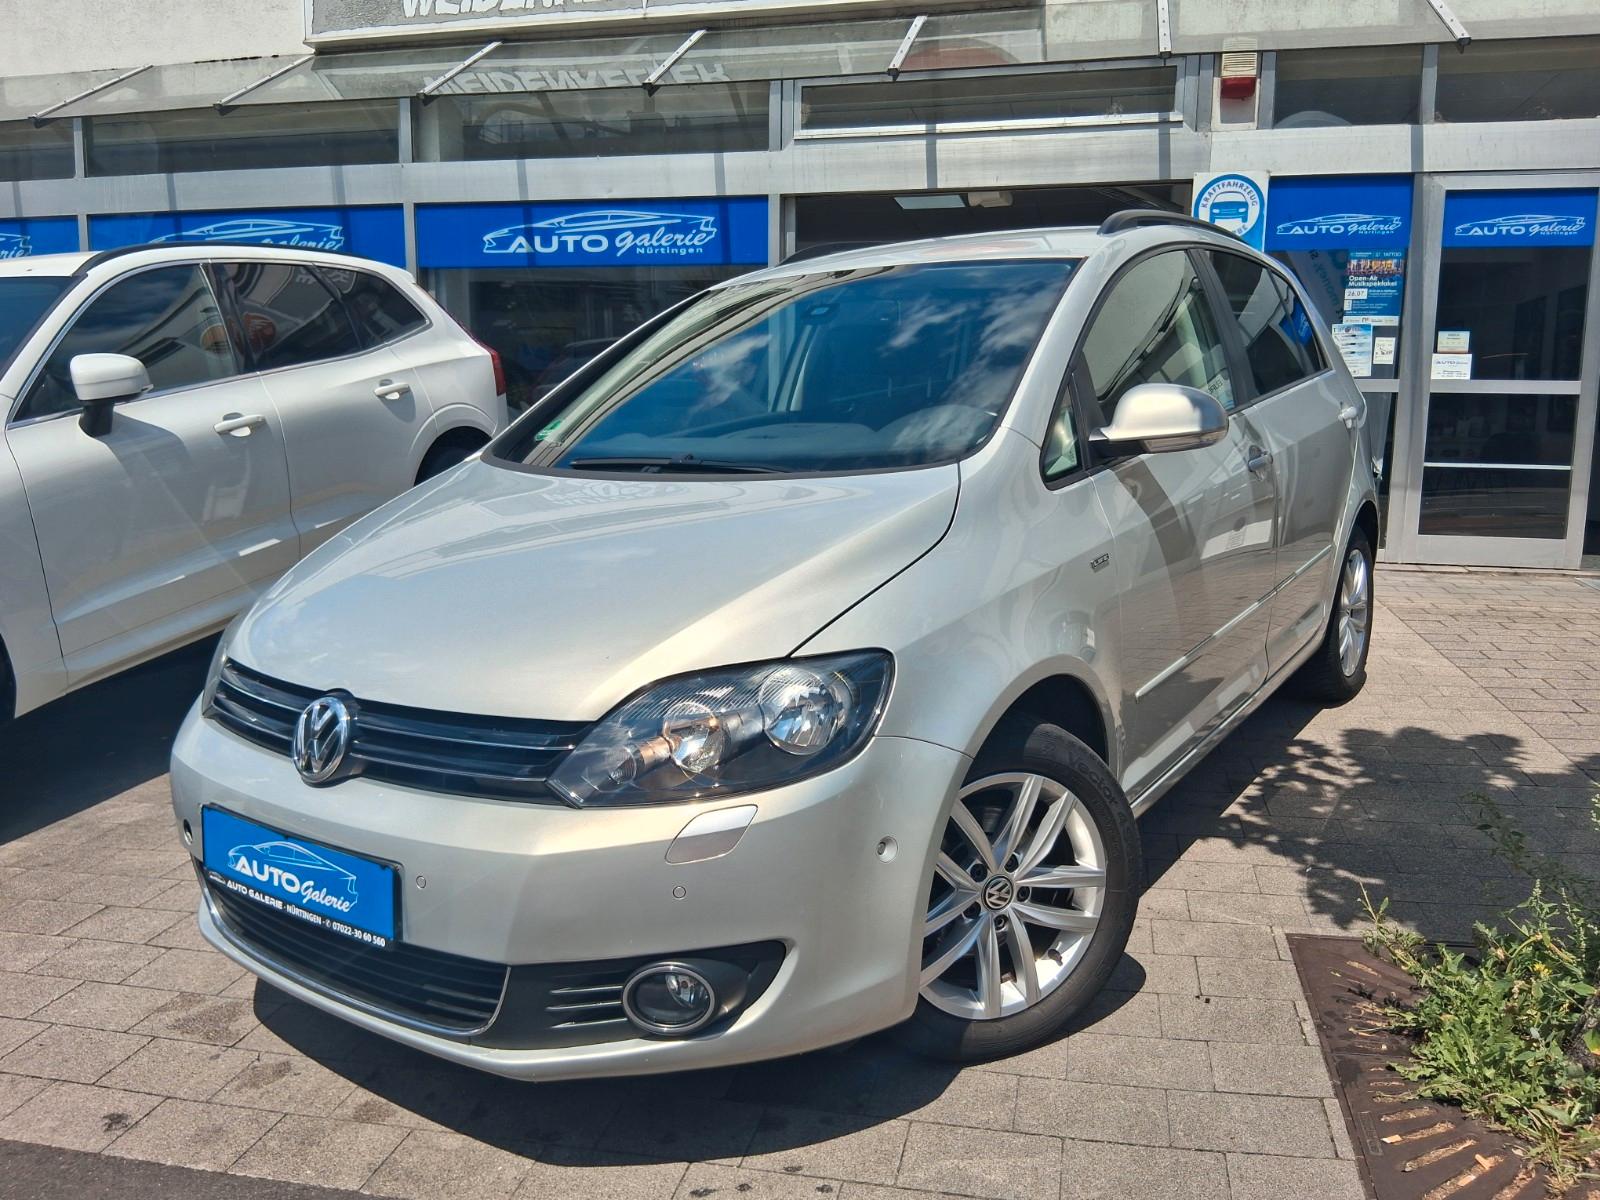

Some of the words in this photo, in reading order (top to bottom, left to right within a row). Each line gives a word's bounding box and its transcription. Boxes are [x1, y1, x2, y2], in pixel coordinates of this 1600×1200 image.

[1201, 181, 1258, 208] KRAFTFAHRZEUG
[1291, 225, 1345, 235] AUTO
[1468, 226, 1526, 236] AUTO
[509, 235, 608, 253] AUTO
[636, 247, 703, 255] Nürtingen
[235, 856, 300, 893] AUTO
[226, 879, 248, 895] AUTO
[248, 889, 284, 910] GALERIE
[286, 904, 322, 925] NÜRTINGEN
[332, 921, 363, 940] 07022-30
[363, 932, 372, 943] 60
[372, 936, 386, 948] 560
